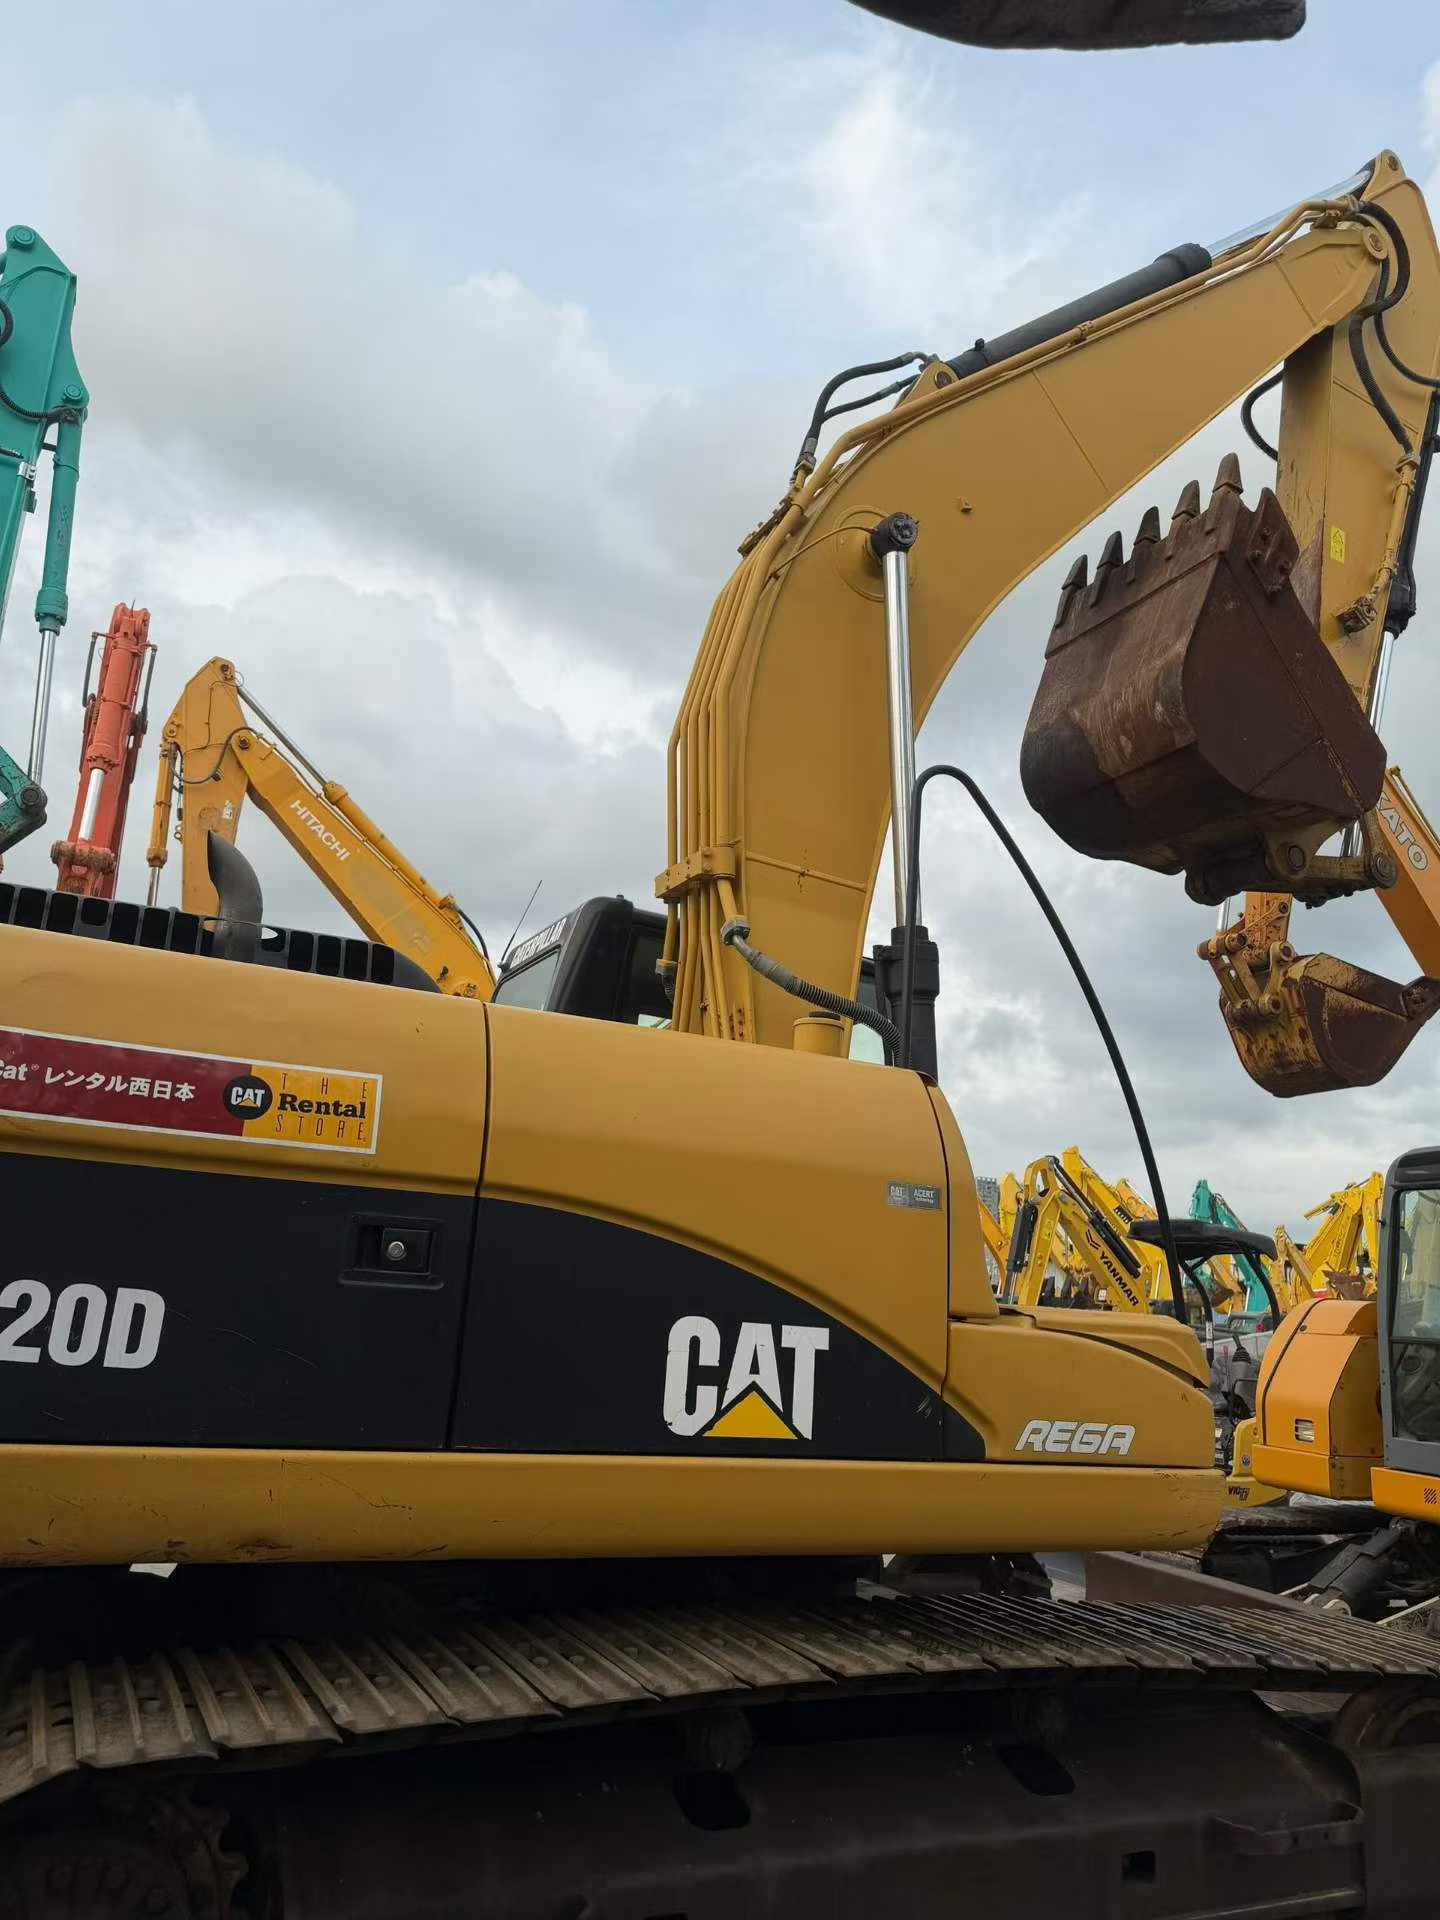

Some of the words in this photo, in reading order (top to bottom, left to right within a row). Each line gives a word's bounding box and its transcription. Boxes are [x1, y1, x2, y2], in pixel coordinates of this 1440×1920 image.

[290, 799, 351, 861] HITACHI
[45, 1066, 196, 1101] レンタル西日本
[231, 1086, 266, 1108] CAT
[277, 1093, 366, 1119] Rental
[276, 1114, 366, 1141] STORE
[1100, 1250, 1140, 1307] YANMAR
[663, 1315, 830, 1441] CAT
[1014, 1418, 1137, 1456] REGA
